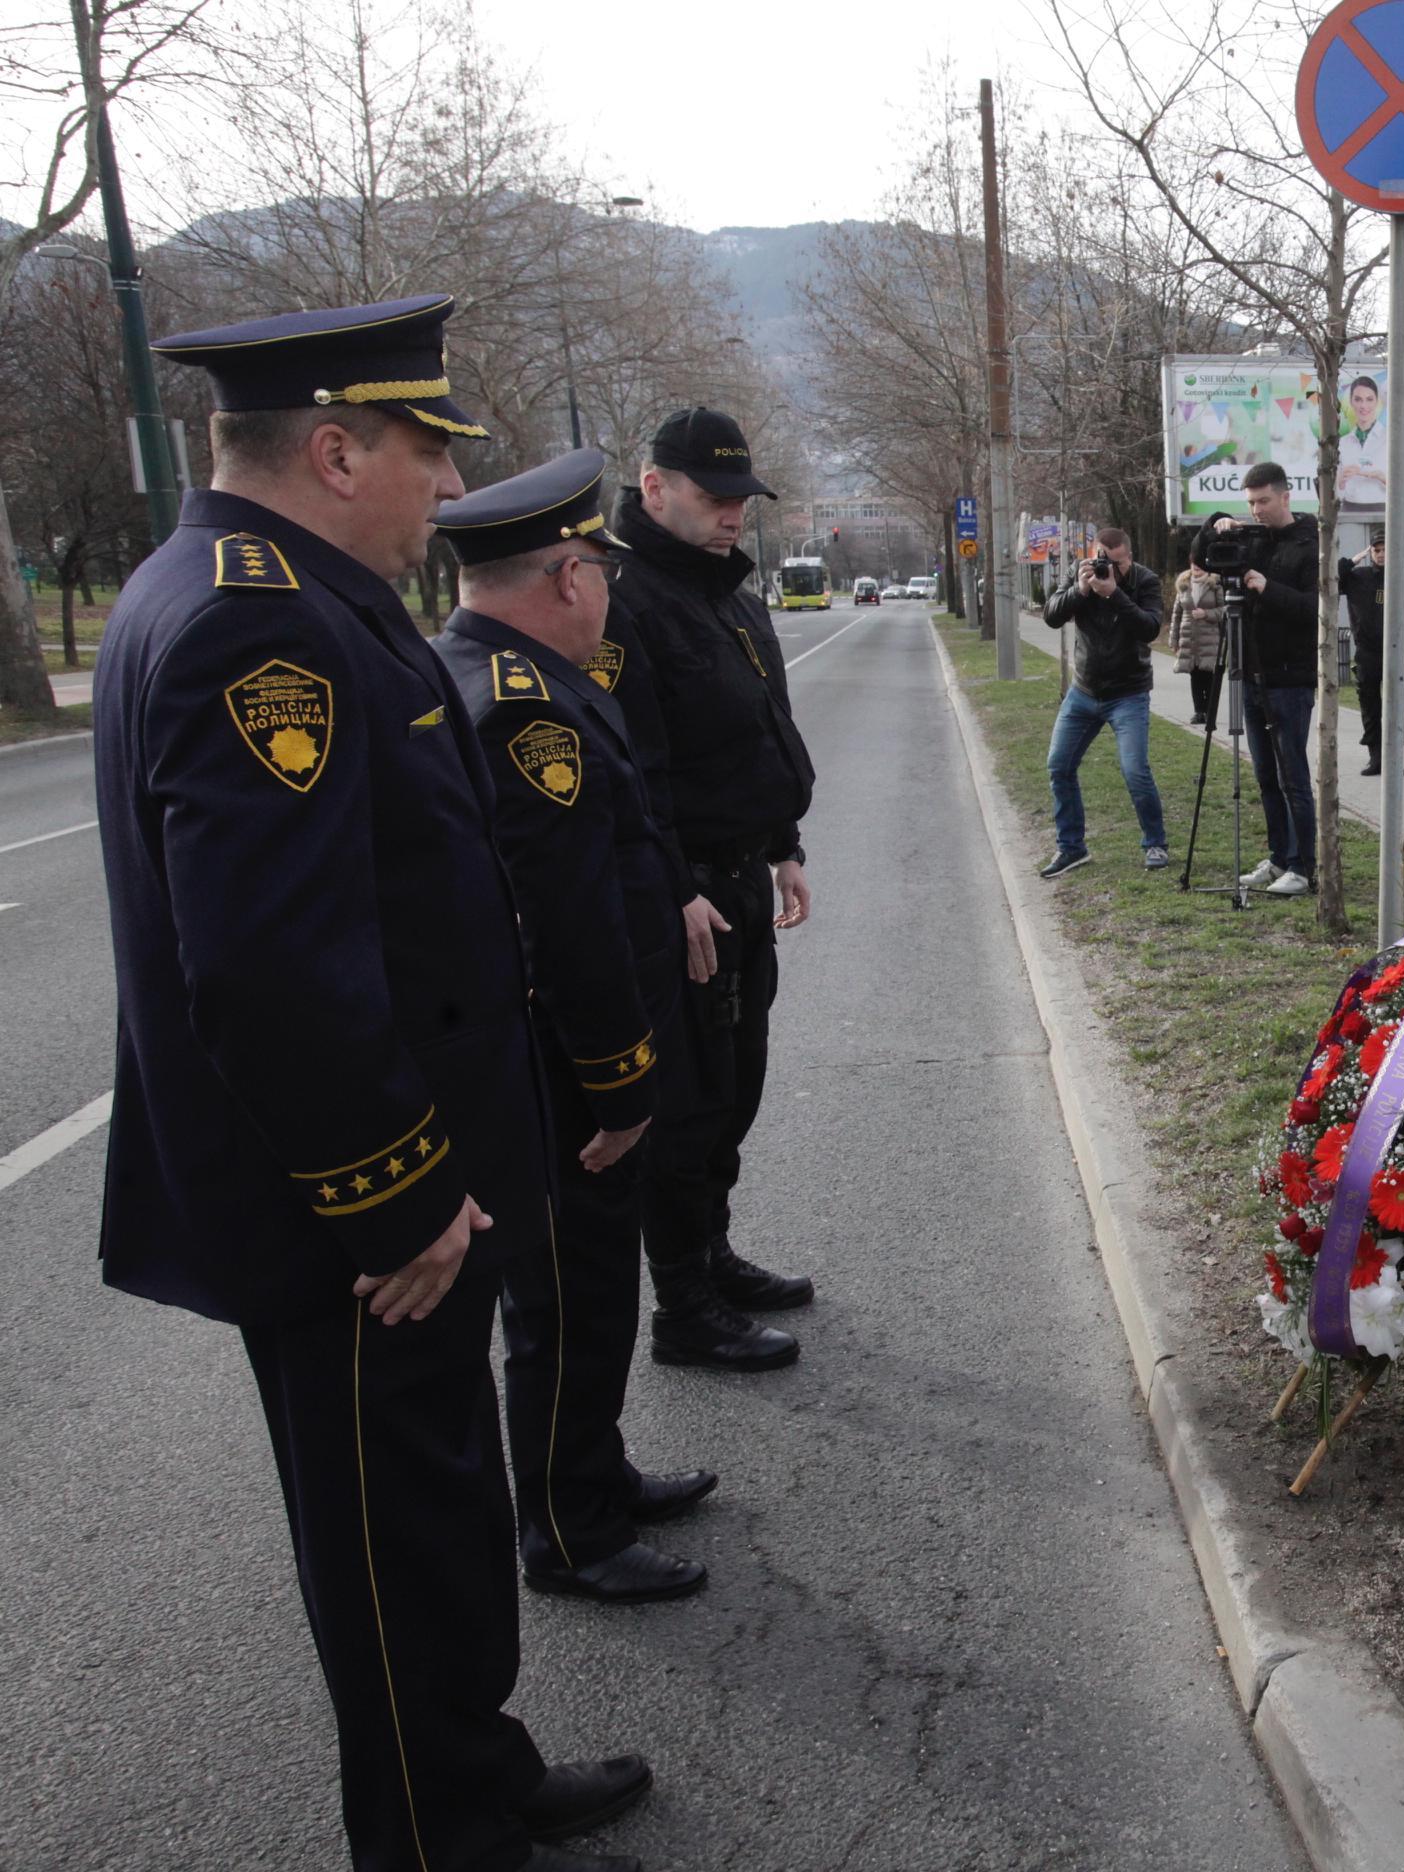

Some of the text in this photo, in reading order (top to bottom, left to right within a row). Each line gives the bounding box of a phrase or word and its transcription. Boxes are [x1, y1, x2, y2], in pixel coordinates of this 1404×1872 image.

[1199, 473, 1245, 492] KUĆ
[960, 499, 973, 517] H
[246, 701, 321, 719] POLICIJA
[245, 713, 325, 732] ПОЛИЦИЈА
[523, 744, 572, 762] POLICIJA
[524, 751, 576, 771] ПОЛИЦИЈА
